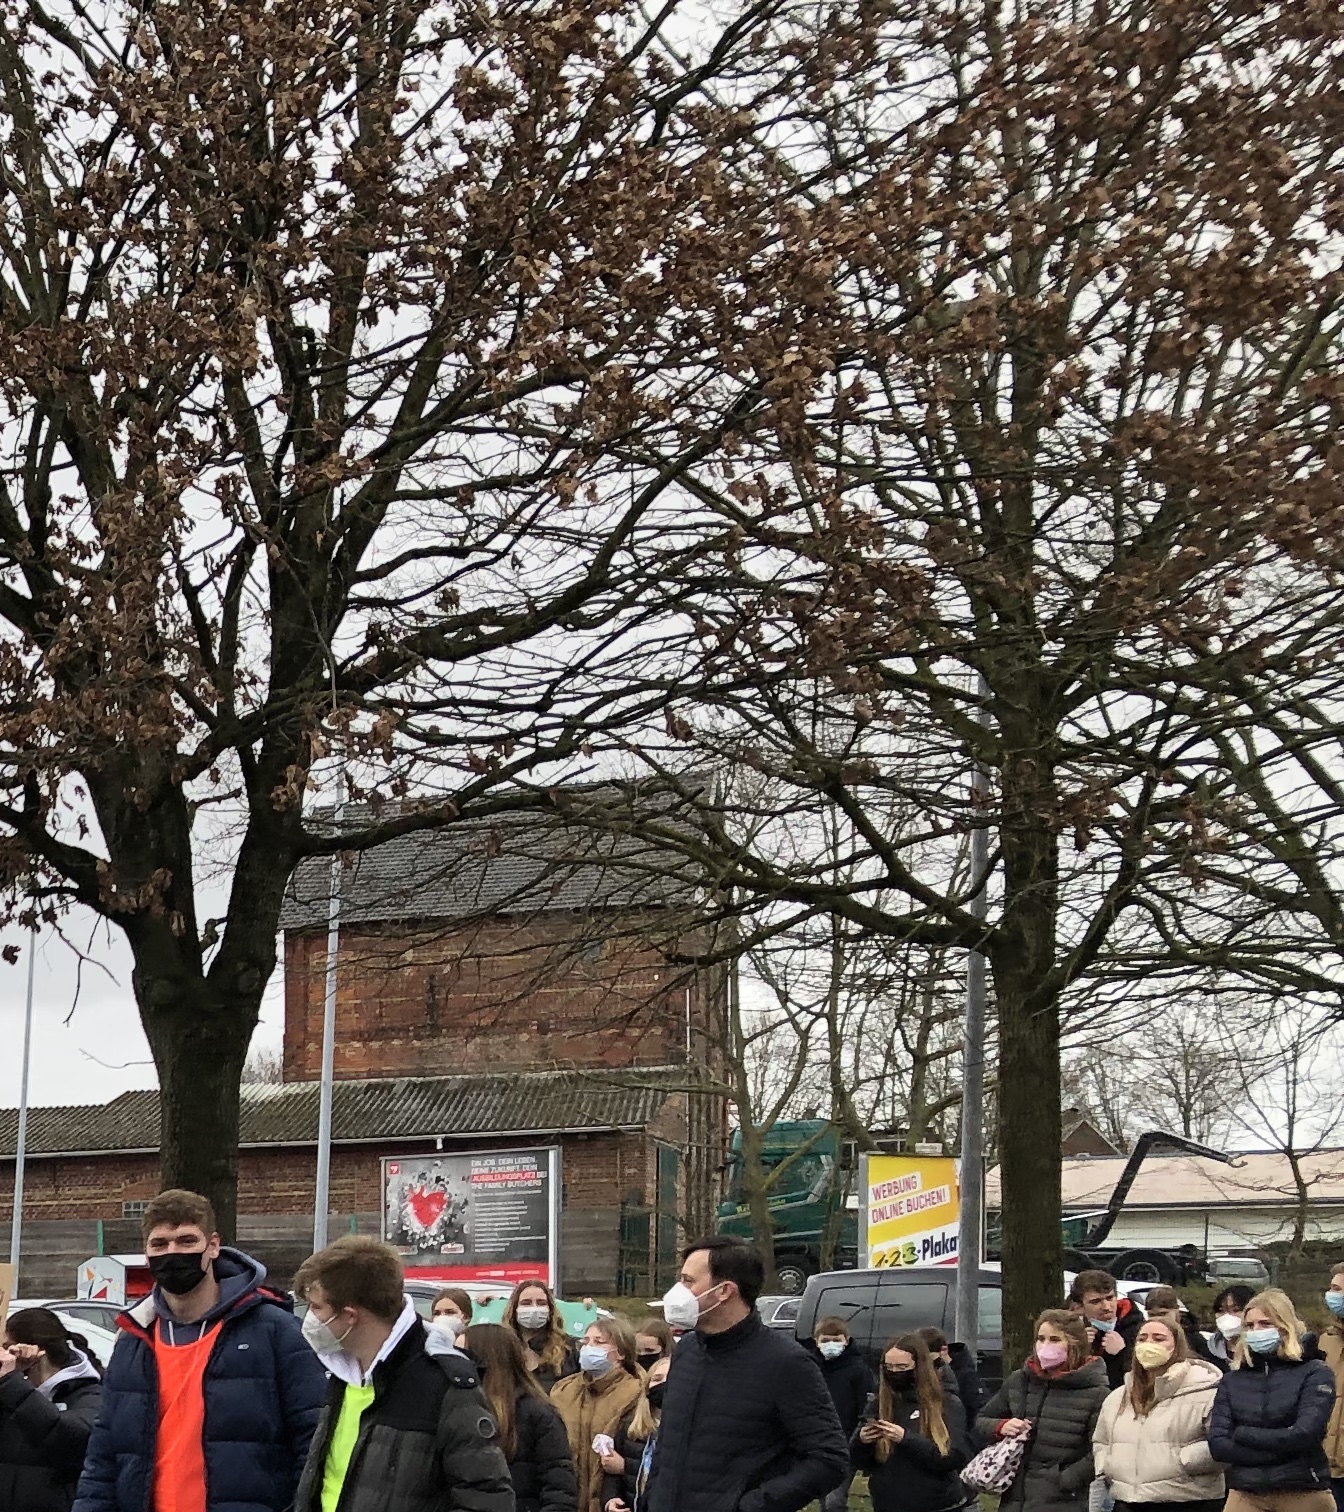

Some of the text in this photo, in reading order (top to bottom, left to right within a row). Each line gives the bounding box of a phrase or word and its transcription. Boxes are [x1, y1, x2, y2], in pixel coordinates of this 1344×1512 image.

[872, 1175, 918, 1201] WERBUNG
[872, 1188, 947, 1223] ONLINE BUCHEN!
